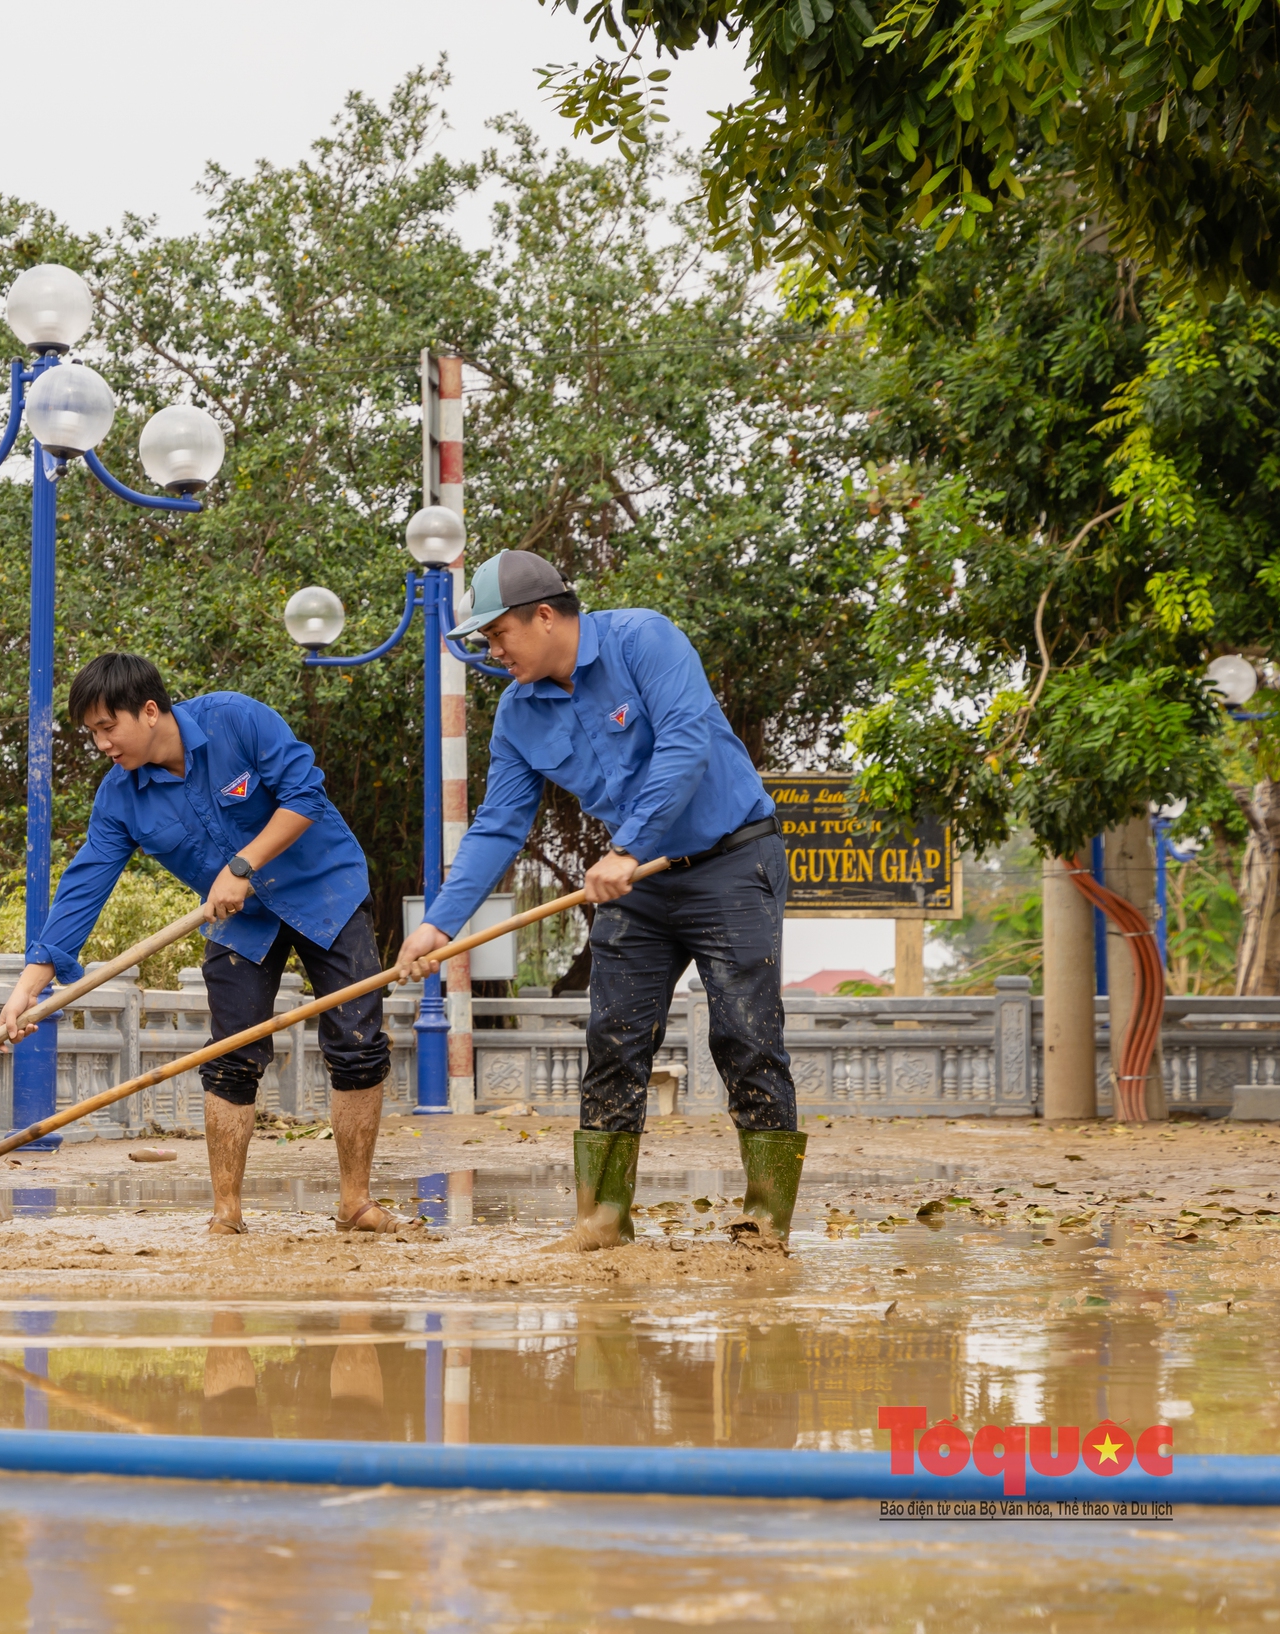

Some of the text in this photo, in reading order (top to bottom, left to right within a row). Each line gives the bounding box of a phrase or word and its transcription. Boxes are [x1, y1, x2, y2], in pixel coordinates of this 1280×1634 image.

[771, 788, 810, 804] Nhà
[782, 820, 817, 837] ĐẠI
[785, 838, 941, 882] GUYÊN GIÁP
